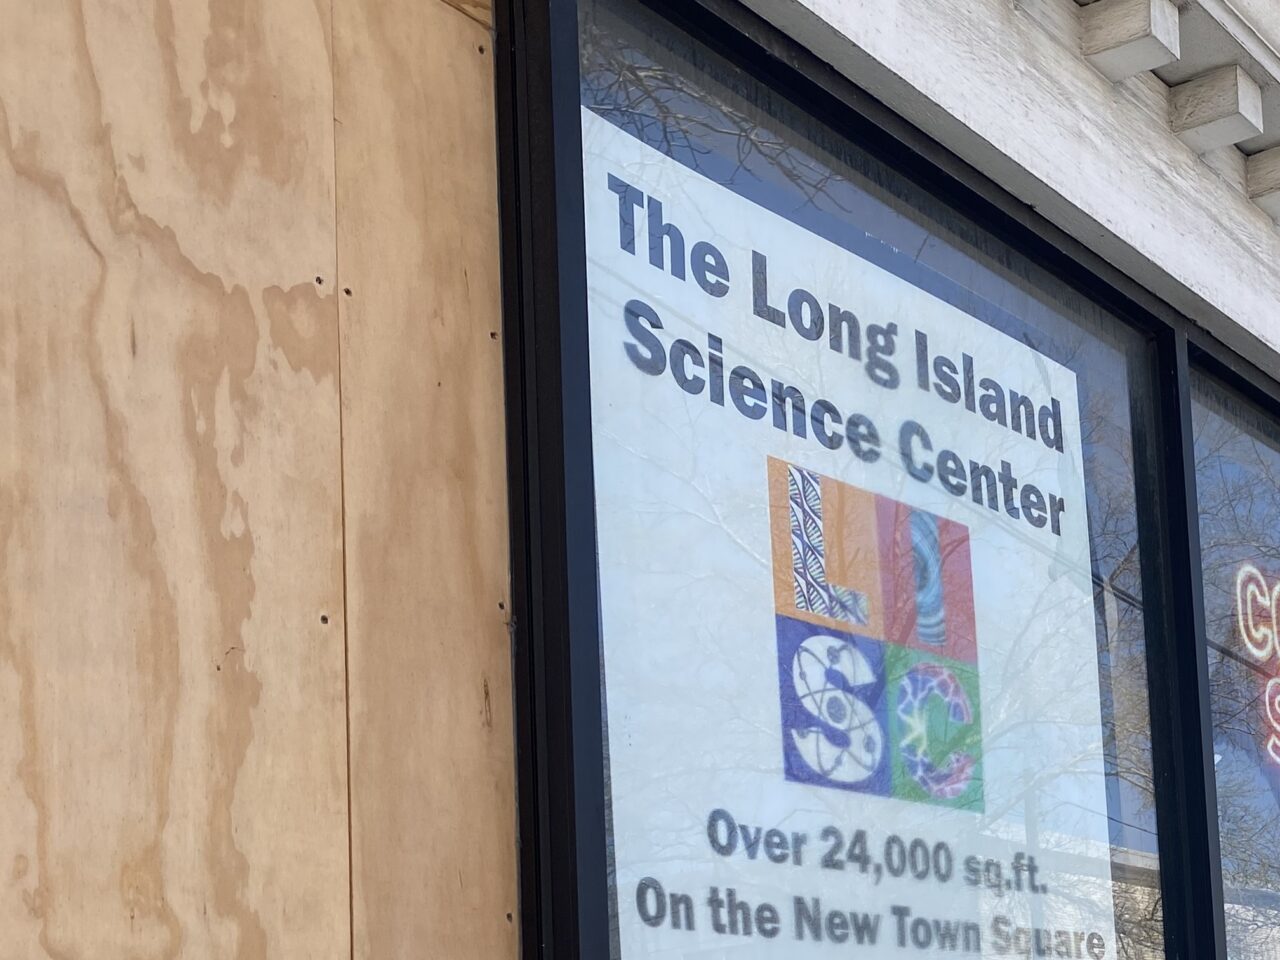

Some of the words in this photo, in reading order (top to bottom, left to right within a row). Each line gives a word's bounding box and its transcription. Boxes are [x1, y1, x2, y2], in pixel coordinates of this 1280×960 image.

[608, 173, 730, 297] The
[751, 250, 899, 389] Long
[915, 330, 1064, 453] Island
[623, 299, 881, 463] Science
[900, 420, 1065, 536] Center
[636, 876, 695, 928] On
[707, 886, 781, 939] the
[793, 896, 880, 945] New
[891, 906, 980, 953] Town
[706, 808, 807, 866] Over
[820, 825, 953, 885] 24,000
[963, 851, 1048, 897] sq.ft.
